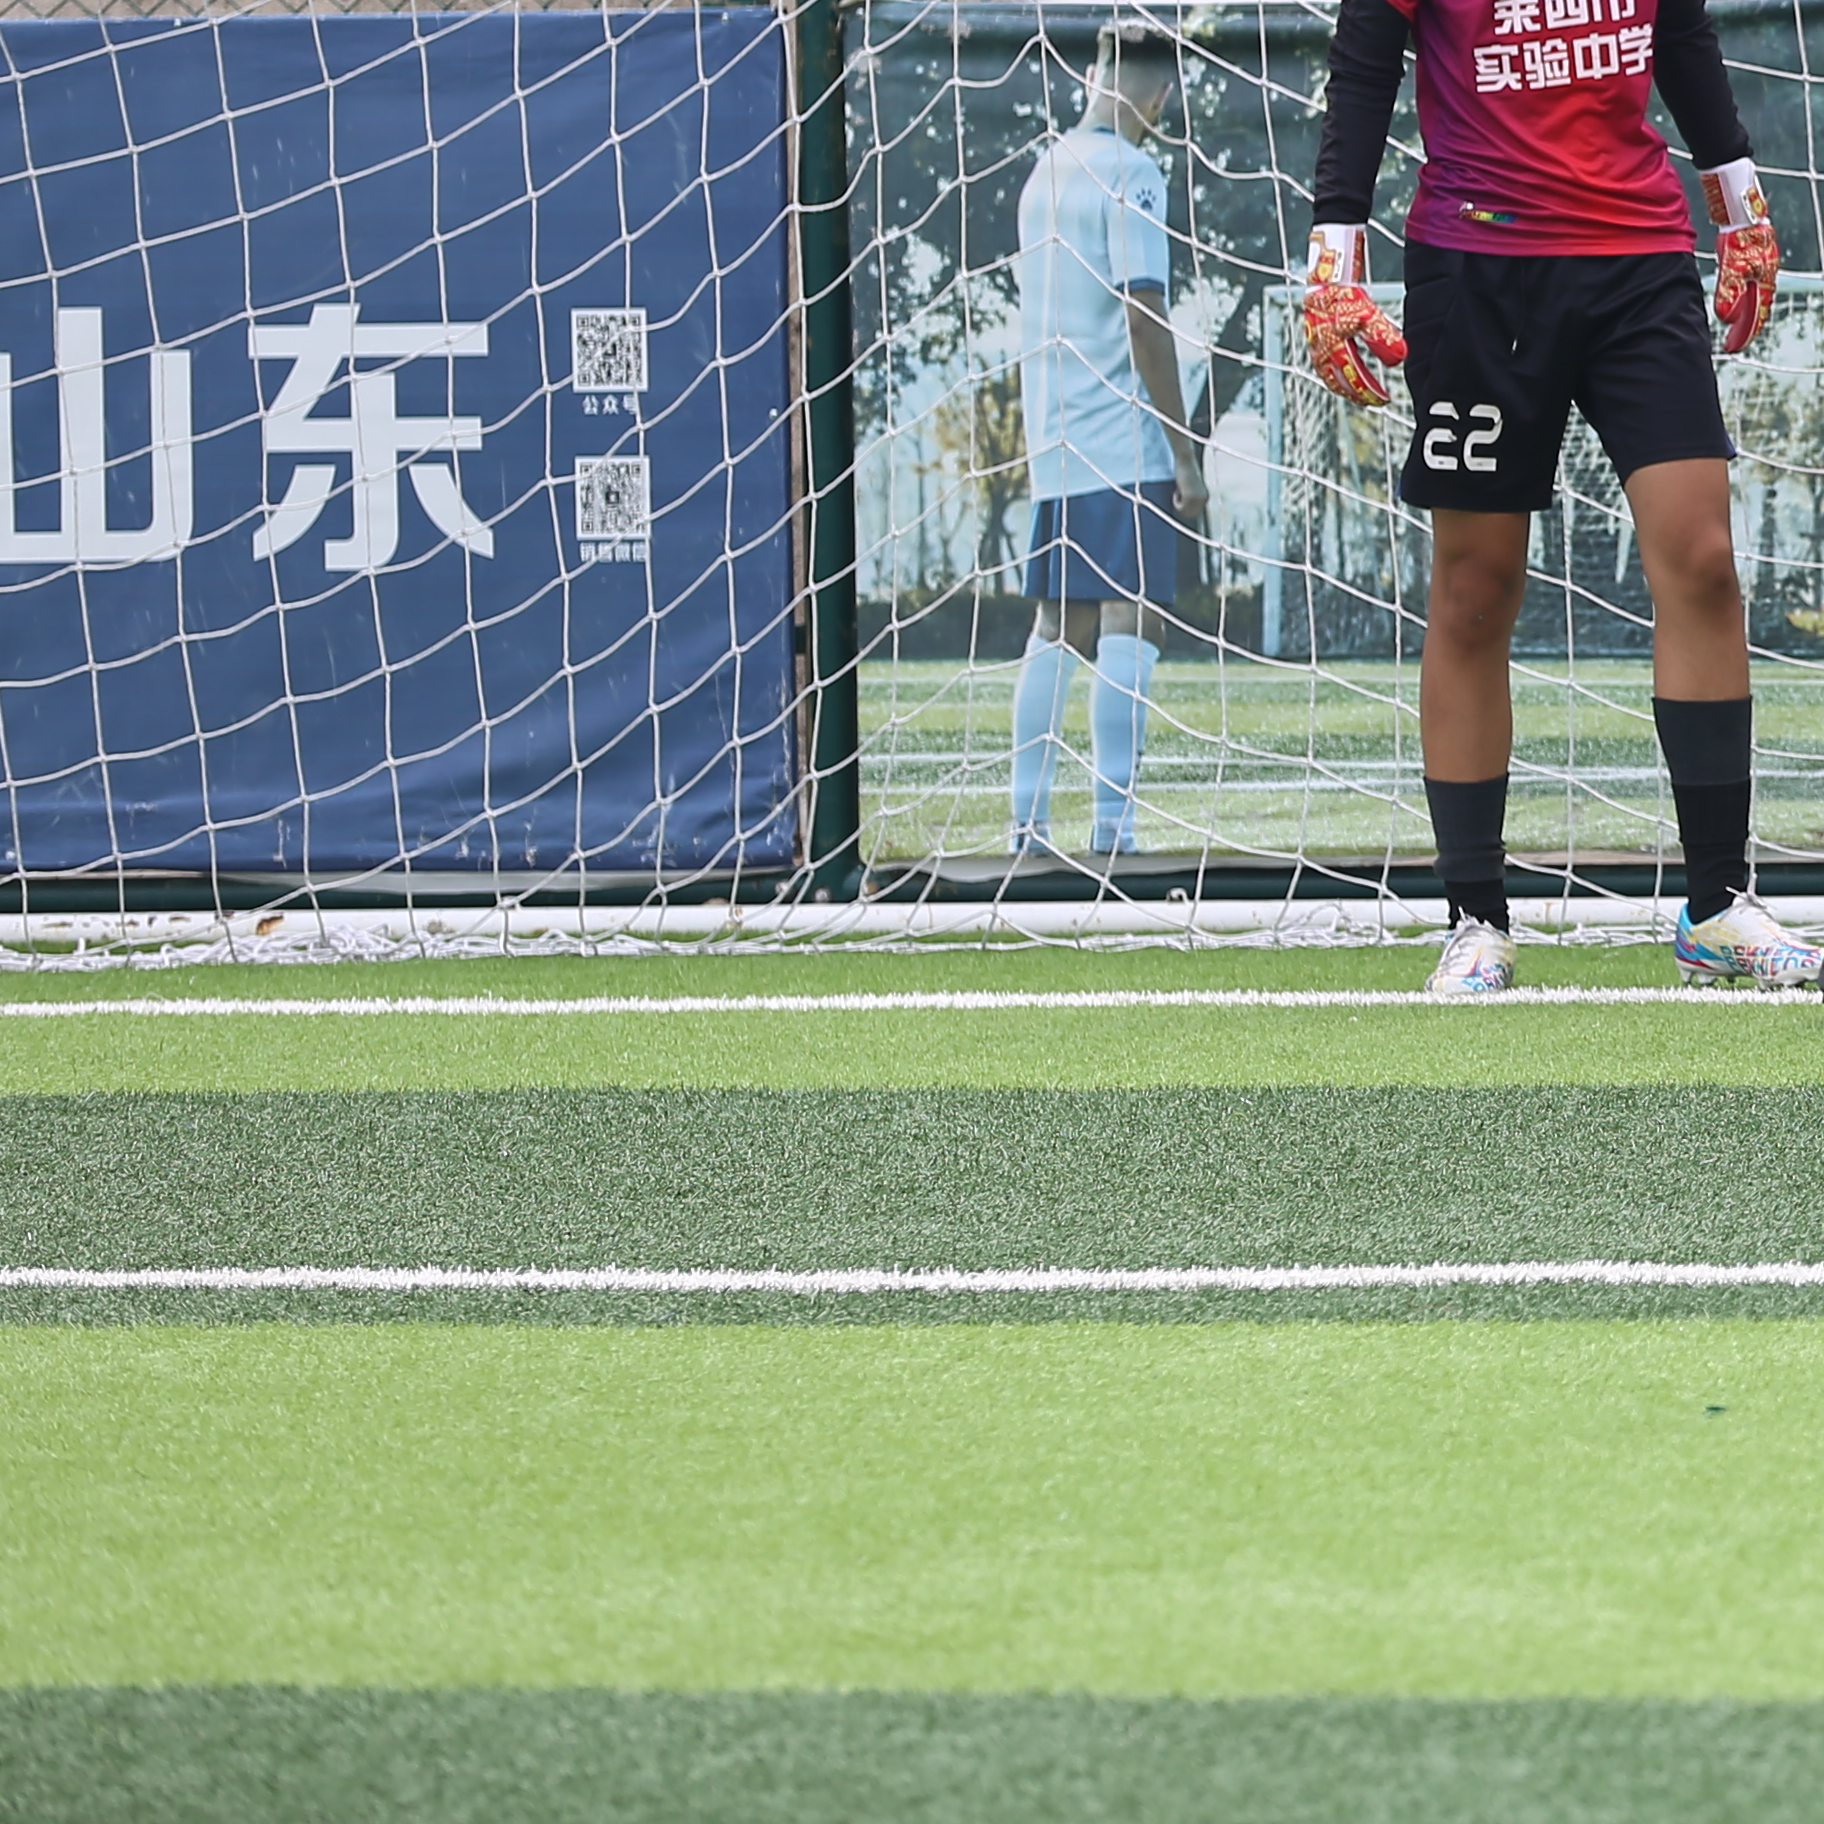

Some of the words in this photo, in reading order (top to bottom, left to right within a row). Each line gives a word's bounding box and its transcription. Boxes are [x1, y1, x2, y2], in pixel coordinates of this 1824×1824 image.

[1473, 23, 1654, 93] 实验中学
[0, 302, 495, 573] 山东
[1423, 401, 1503, 472] 22
